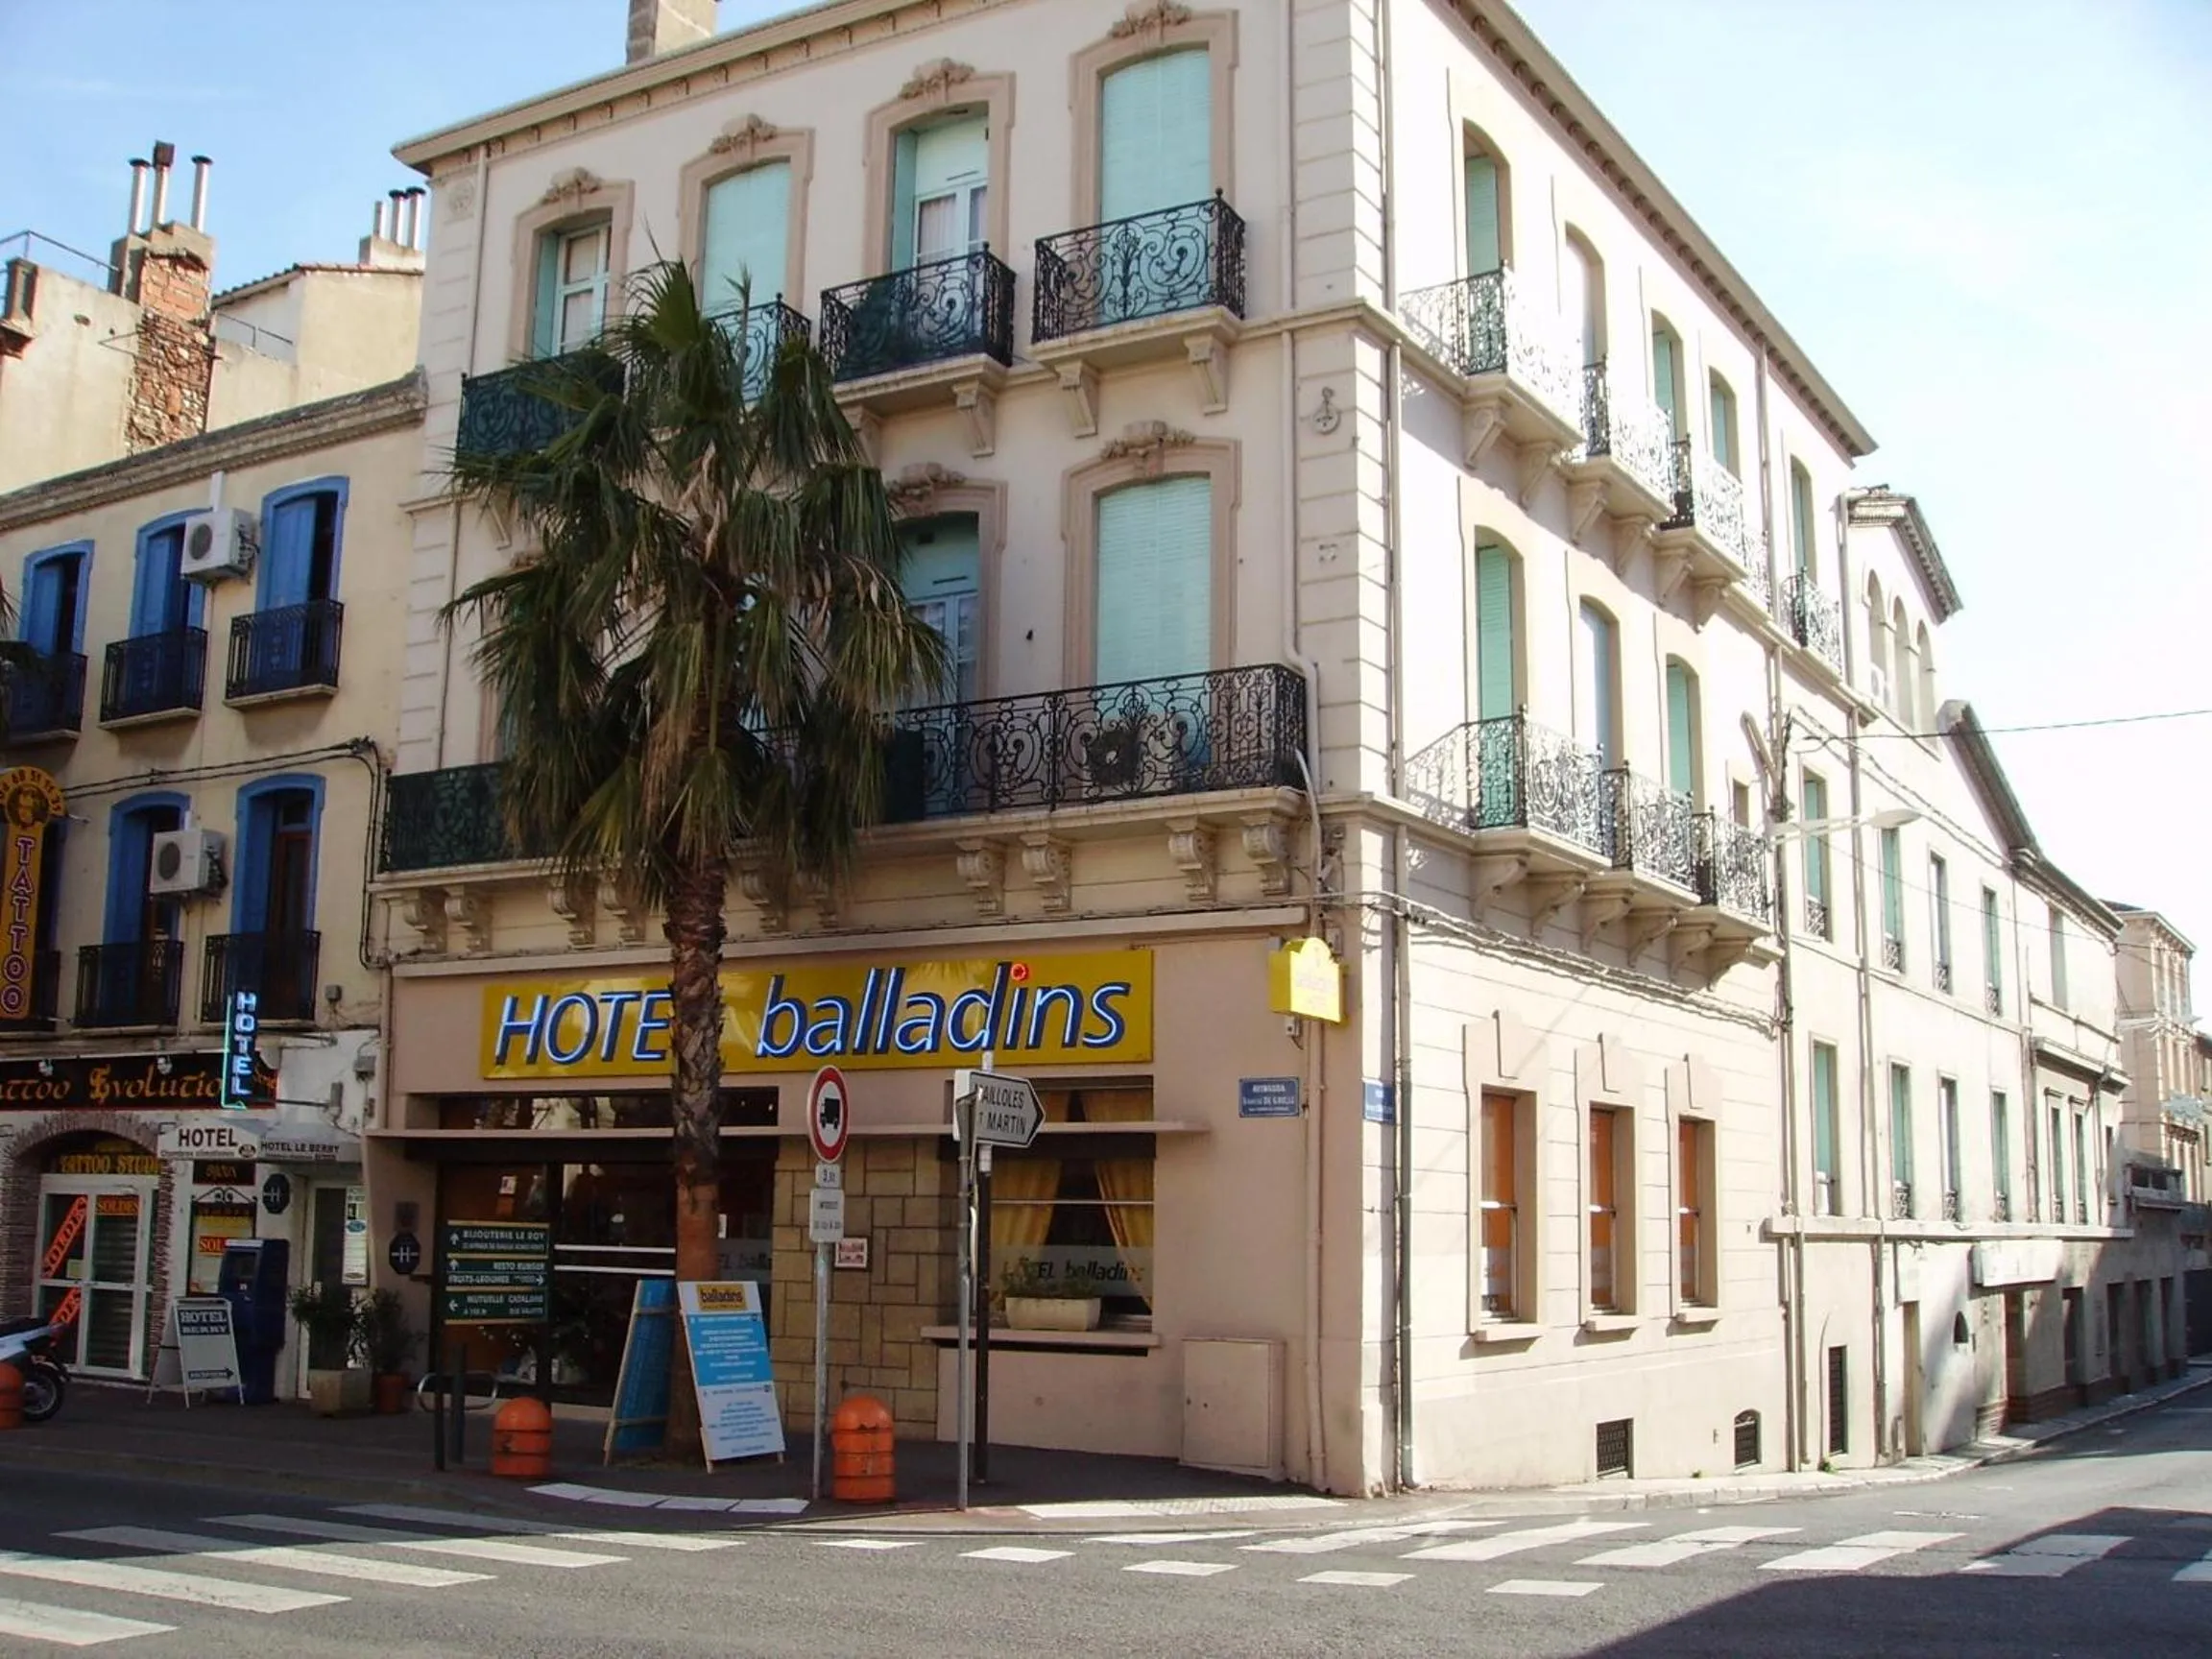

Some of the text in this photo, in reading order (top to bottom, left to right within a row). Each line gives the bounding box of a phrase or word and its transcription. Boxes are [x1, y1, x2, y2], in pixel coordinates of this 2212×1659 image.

[1, 837, 36, 1013] TATTOO
[494, 962, 1131, 1067] HOTE balladins
[231, 991, 256, 1096] HOTEL
[89, 1063, 223, 1104] Evolutio
[974, 1084, 1025, 1110] AILLOLES
[987, 1112, 1026, 1135] MARTIN
[179, 1128, 238, 1147] HOTEL
[260, 1142, 292, 1152] HOTEL
[295, 1143, 306, 1153] LE
[180, 1311, 227, 1323] HOTEL
